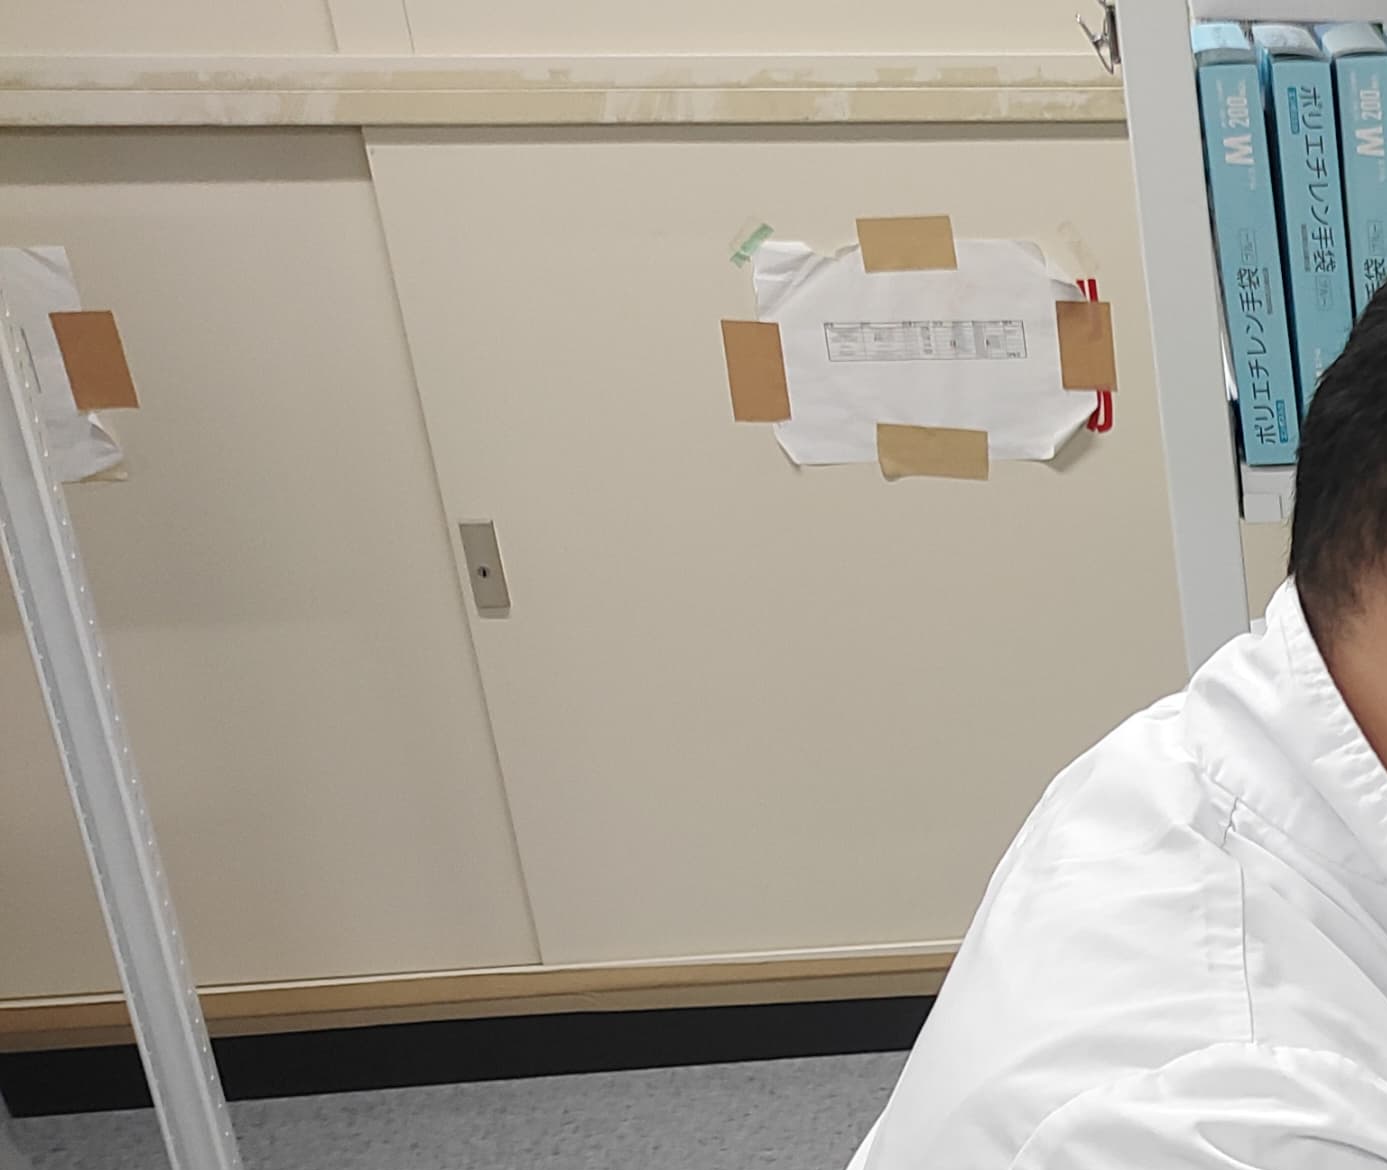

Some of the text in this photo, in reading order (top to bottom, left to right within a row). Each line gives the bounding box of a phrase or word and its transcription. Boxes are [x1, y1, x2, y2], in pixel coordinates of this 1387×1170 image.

[1299, 84, 1337, 273] ポリエチレン手袋
[1236, 267, 1277, 444] ポリエチレン手袋
